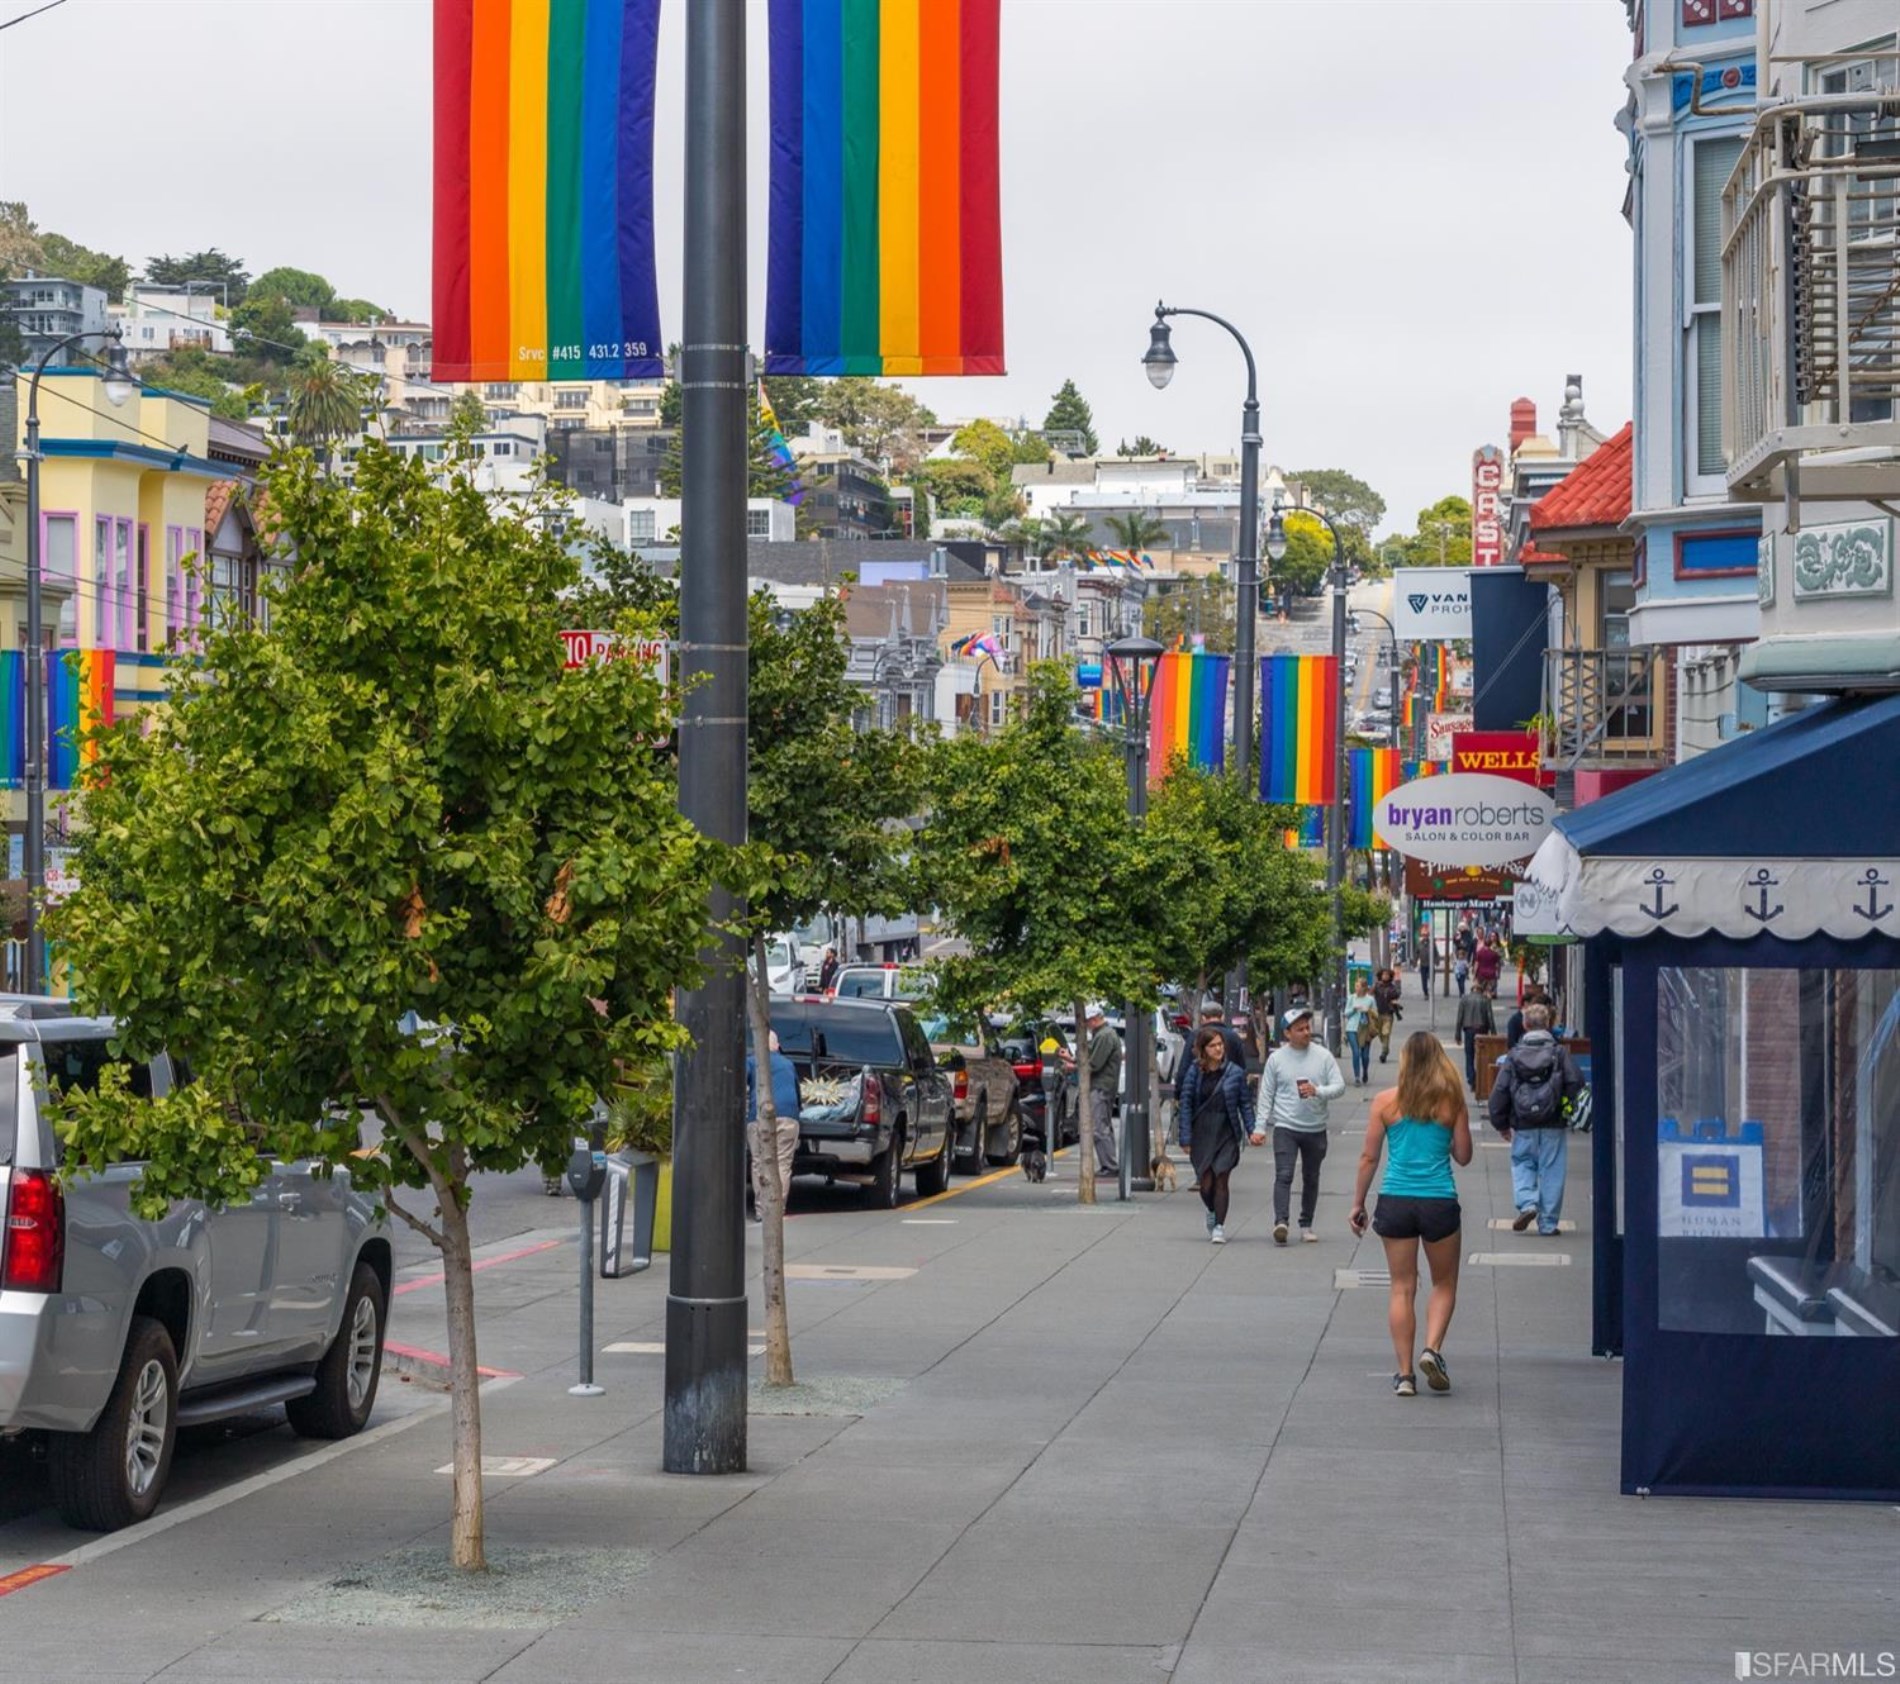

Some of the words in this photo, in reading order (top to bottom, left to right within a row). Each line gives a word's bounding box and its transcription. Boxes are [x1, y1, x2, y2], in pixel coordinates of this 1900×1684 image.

[518, 346, 546, 361] Srvc
[552, 345, 581, 360] #415
[588, 343, 620, 359] 431.2
[624, 342, 648, 357] 359
[1405, 832, 1446, 841] SALON
[1449, 832, 1458, 841] &
[1461, 832, 1502, 841] COLOR
[1505, 832, 1530, 841] BAR
[1422, 899, 1468, 909] Hamburger
[1468, 899, 1502, 909] Mary's
